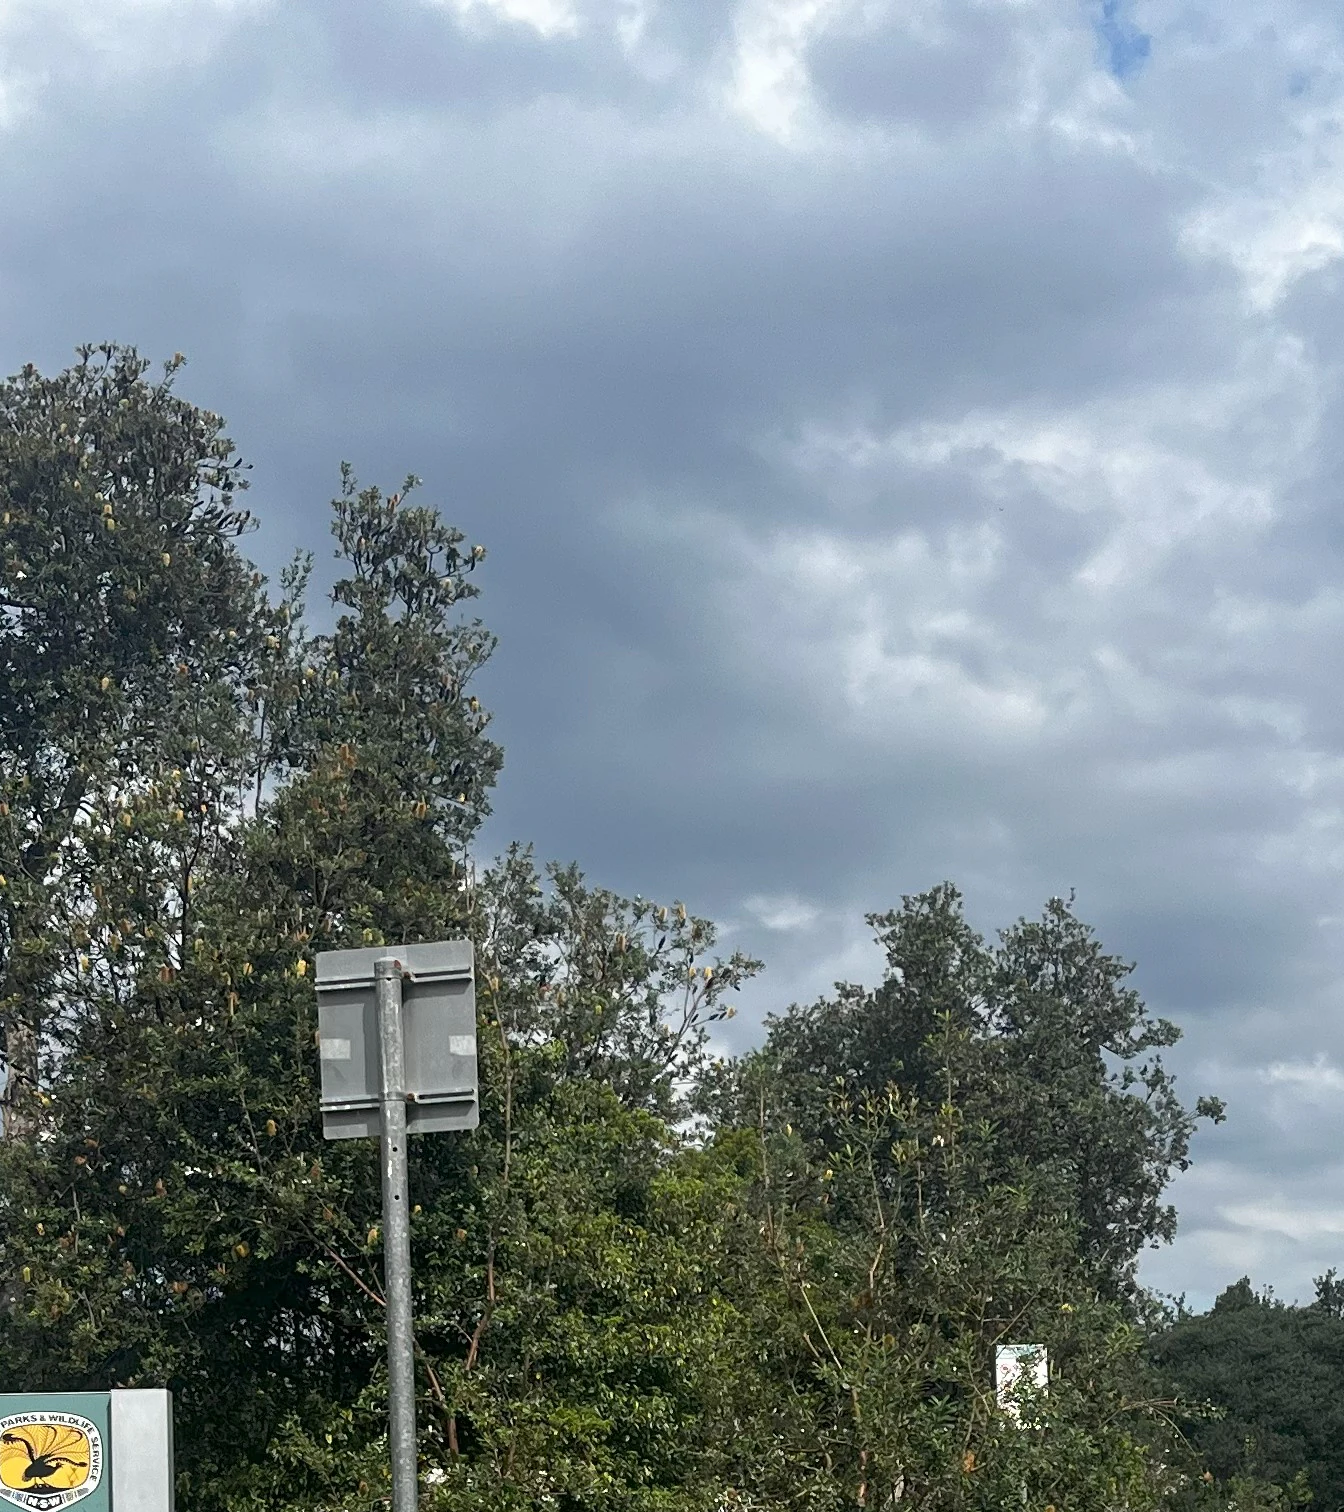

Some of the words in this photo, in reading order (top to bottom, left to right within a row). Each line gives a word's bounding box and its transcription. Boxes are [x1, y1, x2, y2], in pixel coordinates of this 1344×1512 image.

[0, 1414, 37, 1428] PARKS
[39, 1414, 47, 1422] &
[48, 1414, 95, 1435] WILDLIFE
[89, 1436, 100, 1482] SERVICE
